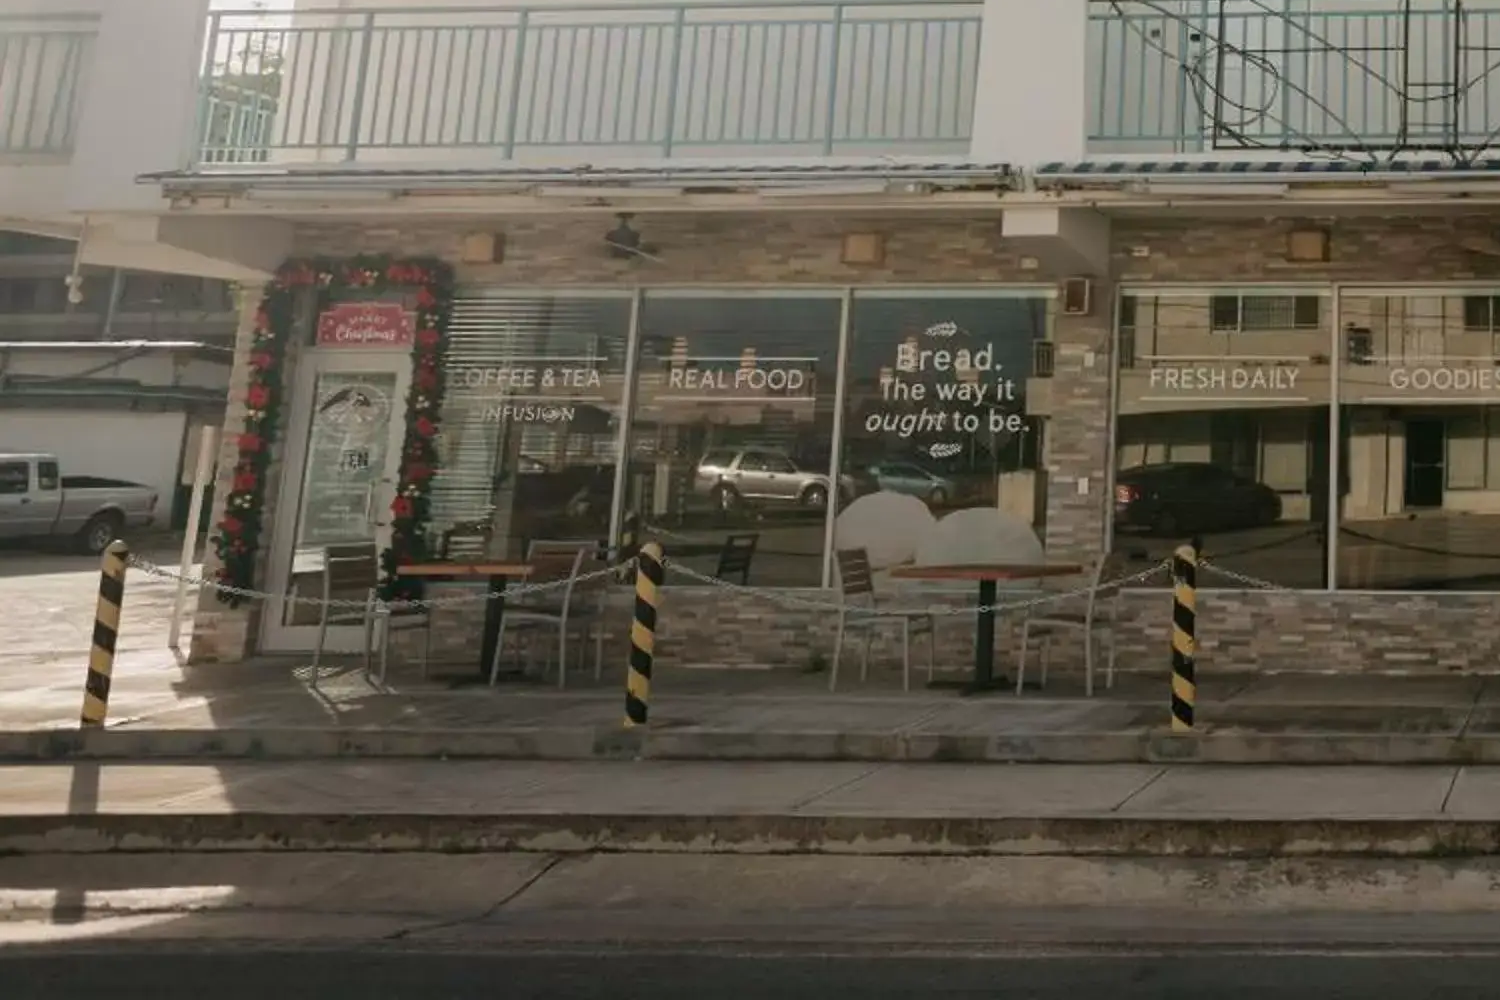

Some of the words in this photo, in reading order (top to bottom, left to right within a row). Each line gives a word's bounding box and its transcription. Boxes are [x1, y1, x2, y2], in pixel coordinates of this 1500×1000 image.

[896, 342, 1003, 372] Bread.
[449, 368, 537, 388] COFFEE
[541, 367, 555, 388] &
[560, 368, 601, 388] TEA
[669, 368, 729, 389] REAL
[735, 368, 804, 390] FOOD
[1150, 368, 1226, 389] FRESH
[1231, 368, 1300, 389] DAILY
[880, 376, 927, 401] The
[936, 382, 988, 407] way
[997, 376, 1016, 401] it
[479, 406, 576, 423] INFUSION
[865, 407, 948, 438] ought
[952, 410, 980, 432] to
[989, 408, 1031, 433] be.
